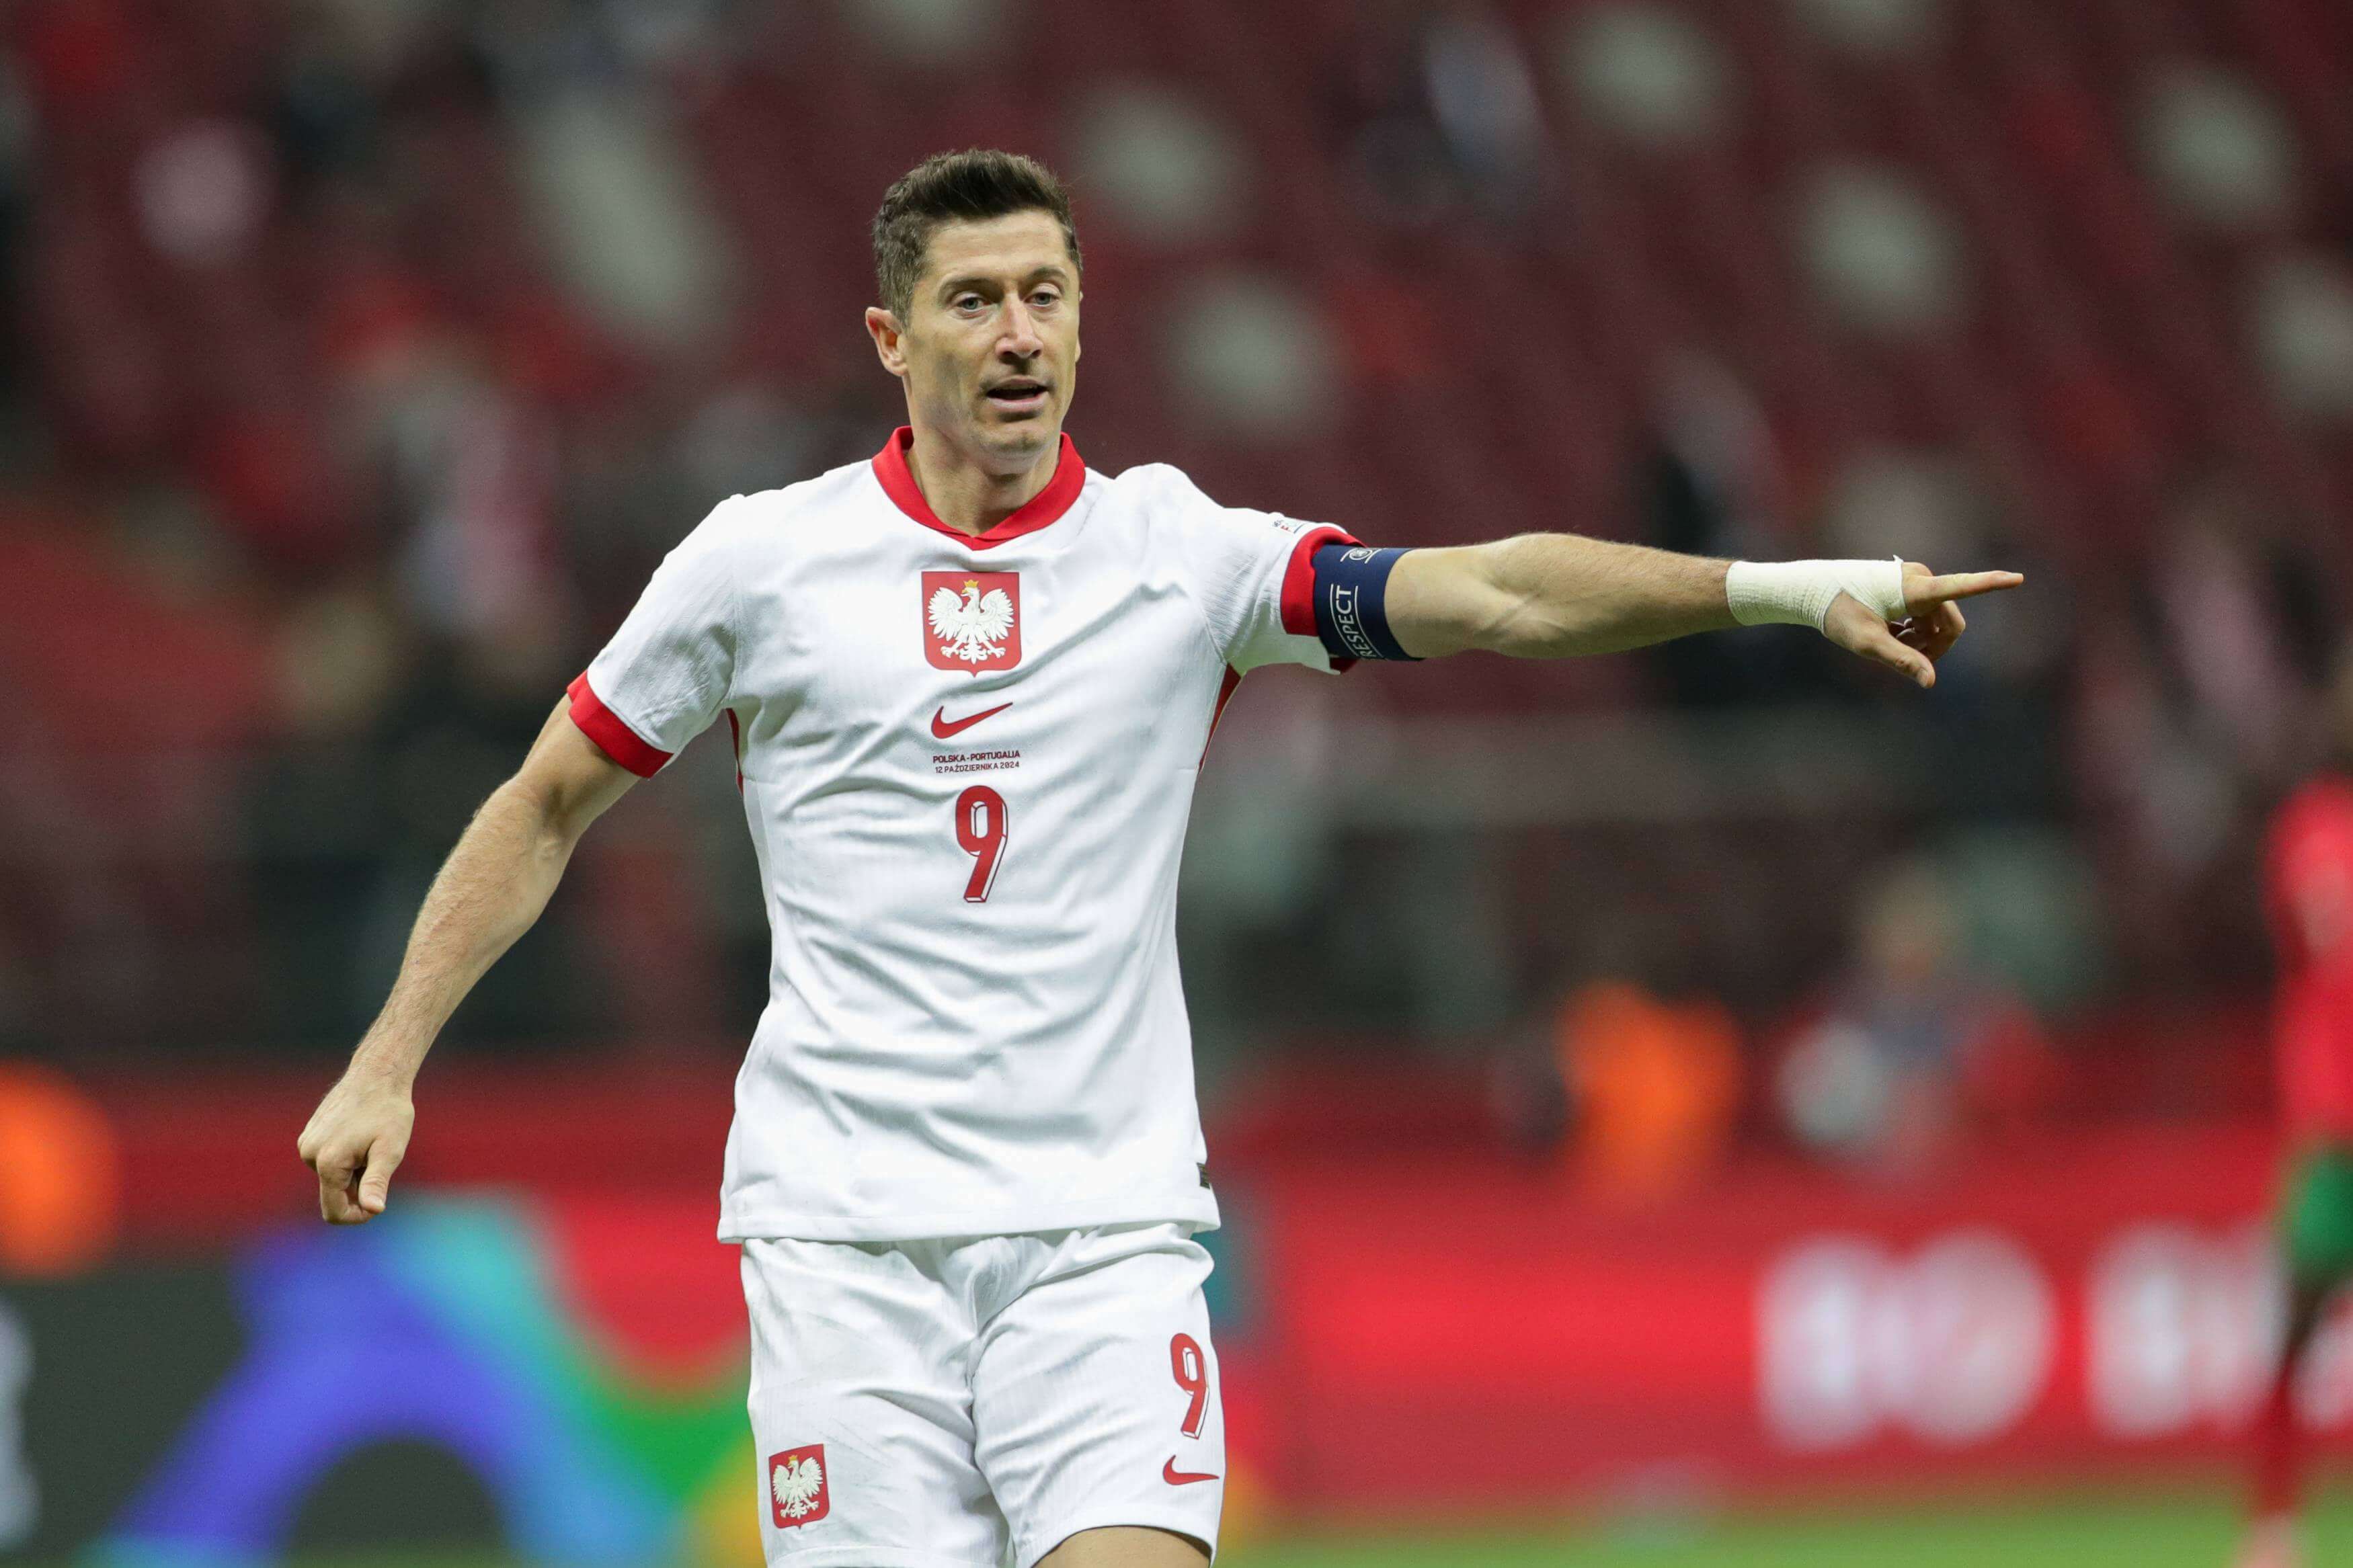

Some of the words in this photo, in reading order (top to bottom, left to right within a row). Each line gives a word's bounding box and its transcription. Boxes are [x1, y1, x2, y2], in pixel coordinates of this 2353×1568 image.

[1336, 585, 1377, 657] RESPECT
[1000, 761, 1020, 770] 2024
[955, 785, 1008, 903] 9
[1170, 1333, 1209, 1440] 9
